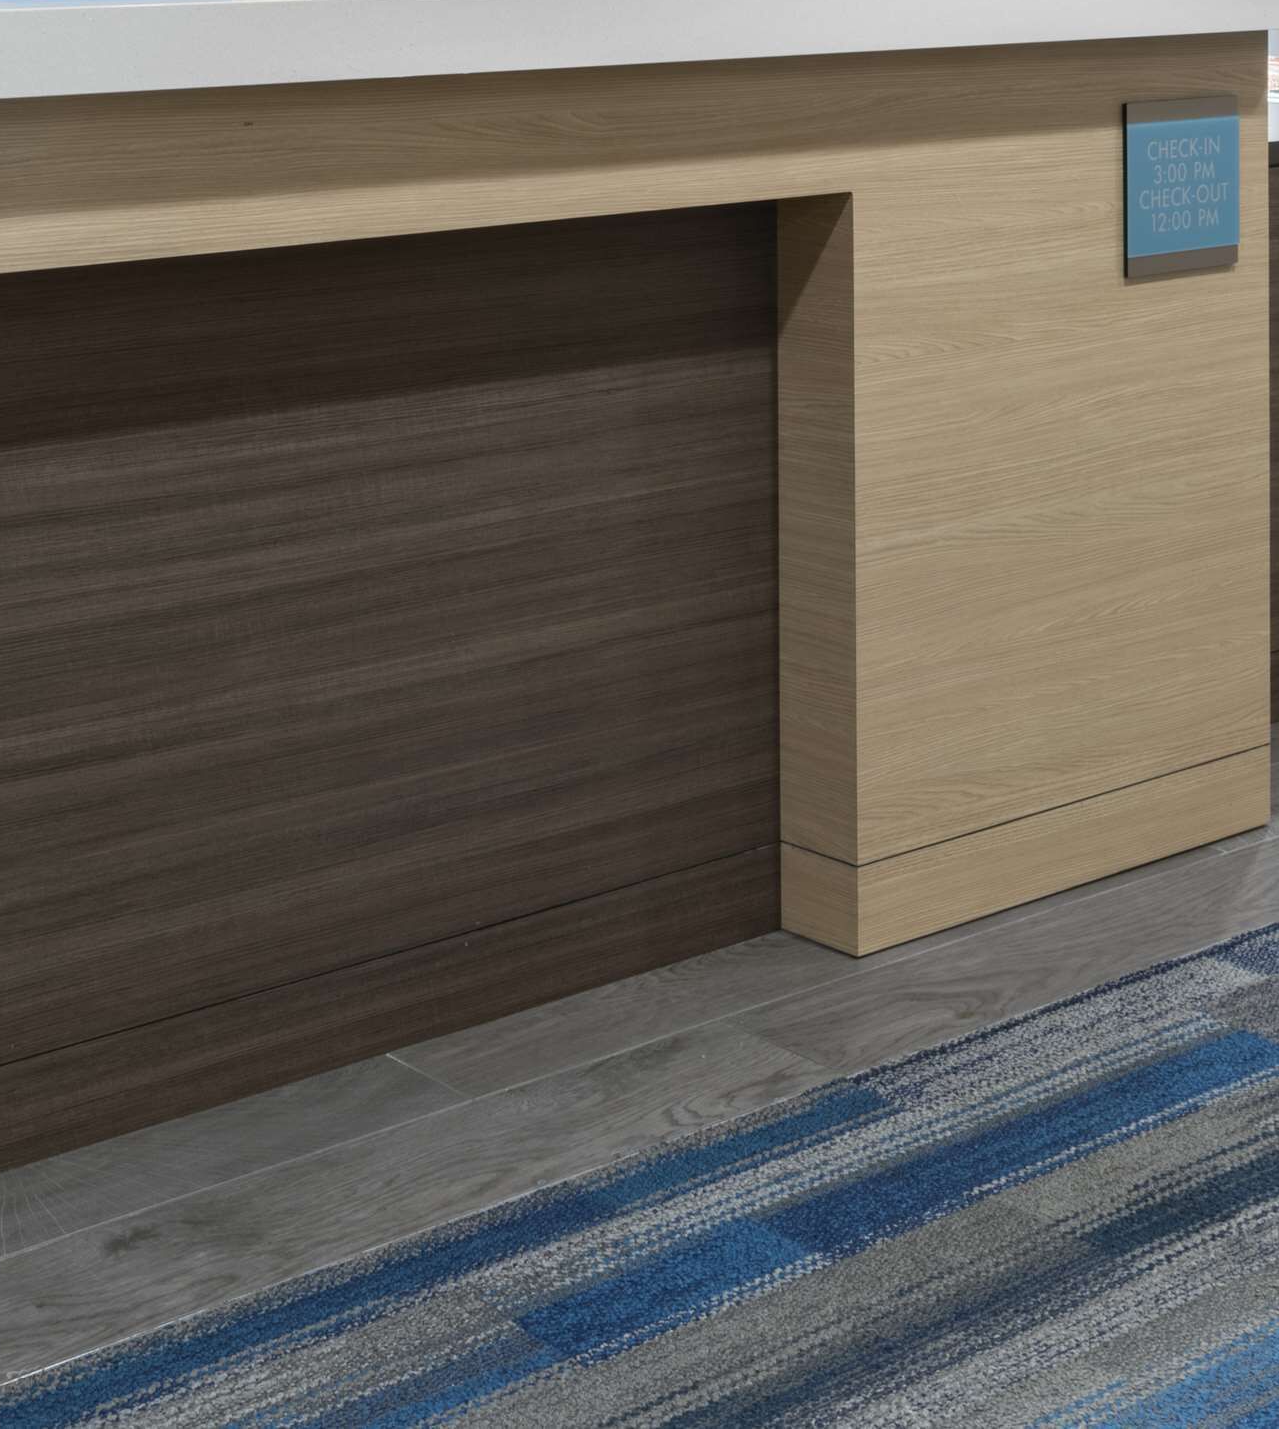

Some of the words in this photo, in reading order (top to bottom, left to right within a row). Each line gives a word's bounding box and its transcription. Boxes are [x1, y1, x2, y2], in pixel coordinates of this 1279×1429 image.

[1147, 135, 1221, 161] CHECK-IN
[1153, 162, 1187, 185] 3:00
[1194, 161, 1216, 179] PM
[1139, 182, 1229, 210] CHECK-OUT
[1151, 210, 1192, 233] 12:00
[1198, 209, 1219, 227] PM
